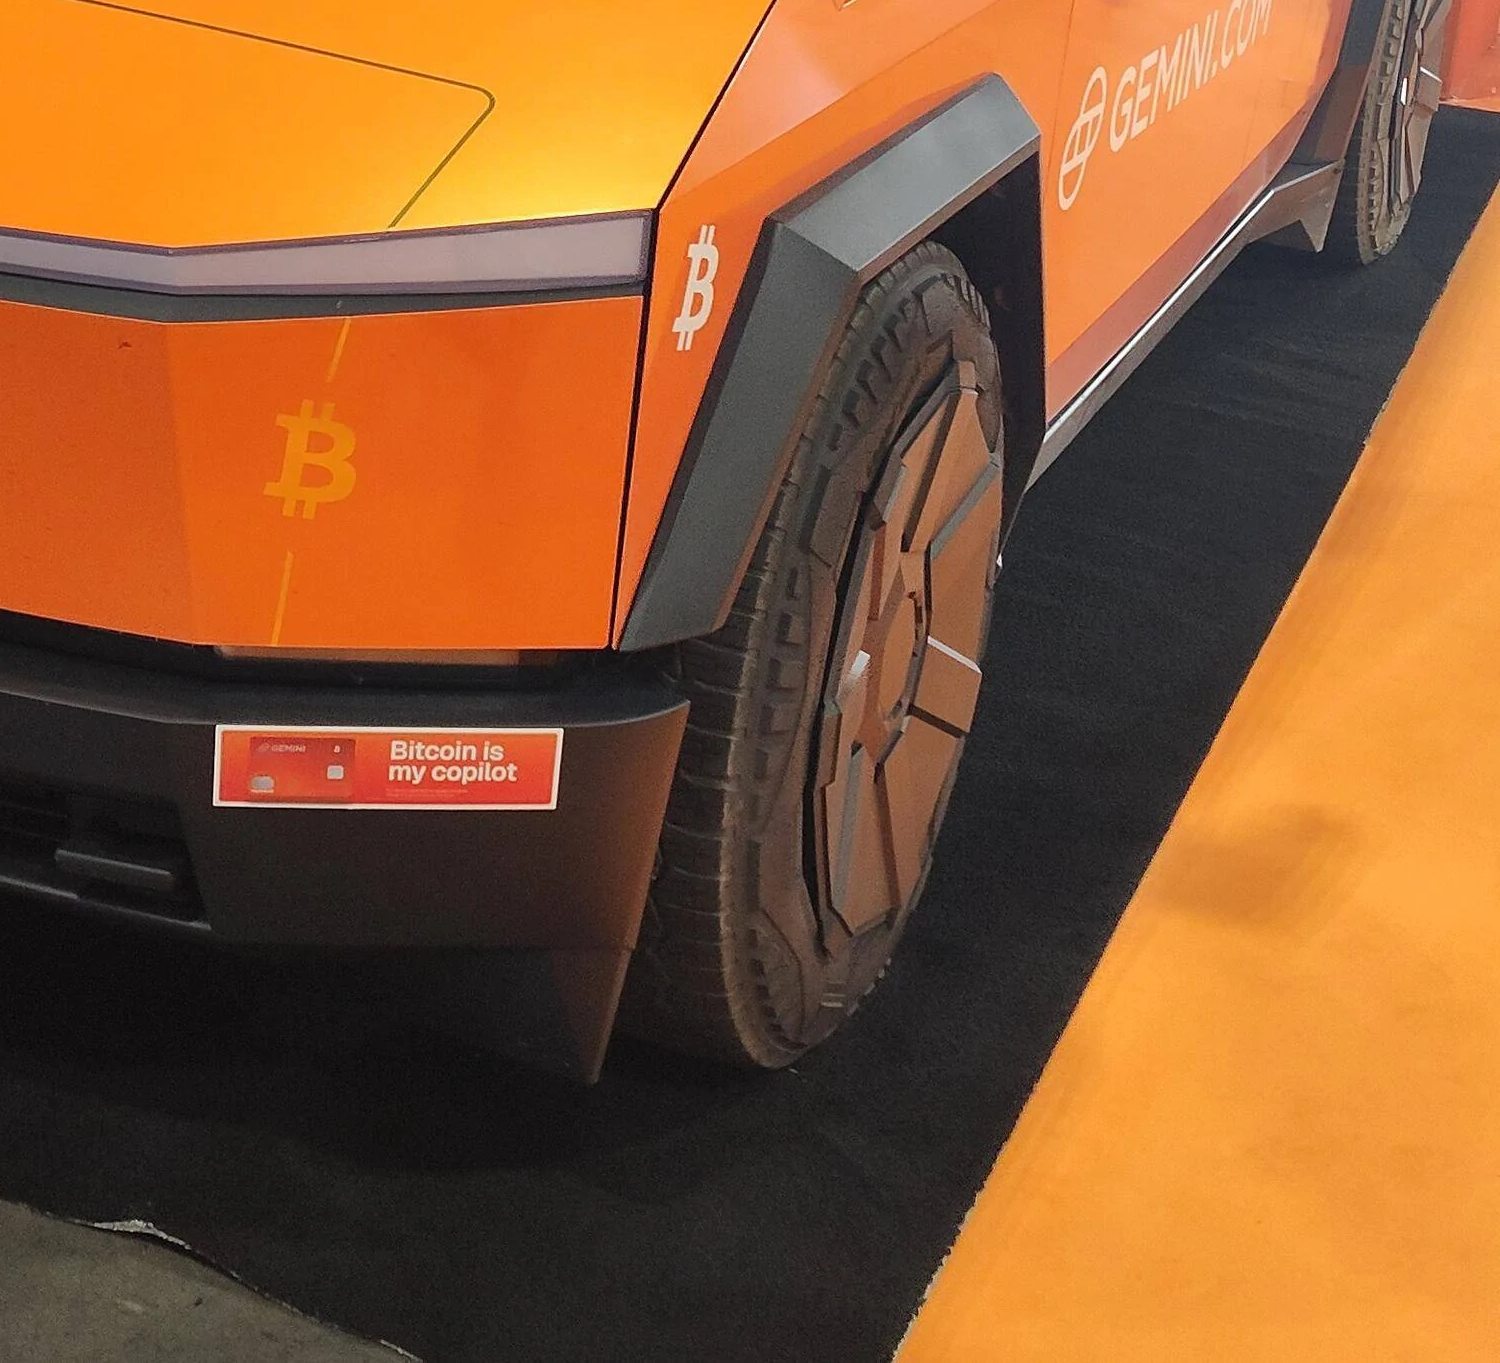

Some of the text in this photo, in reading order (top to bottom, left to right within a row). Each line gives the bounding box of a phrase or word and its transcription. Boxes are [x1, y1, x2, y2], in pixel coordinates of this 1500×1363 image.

[390, 739, 505, 761] Bitcoin is
[388, 761, 518, 785] my copilot
